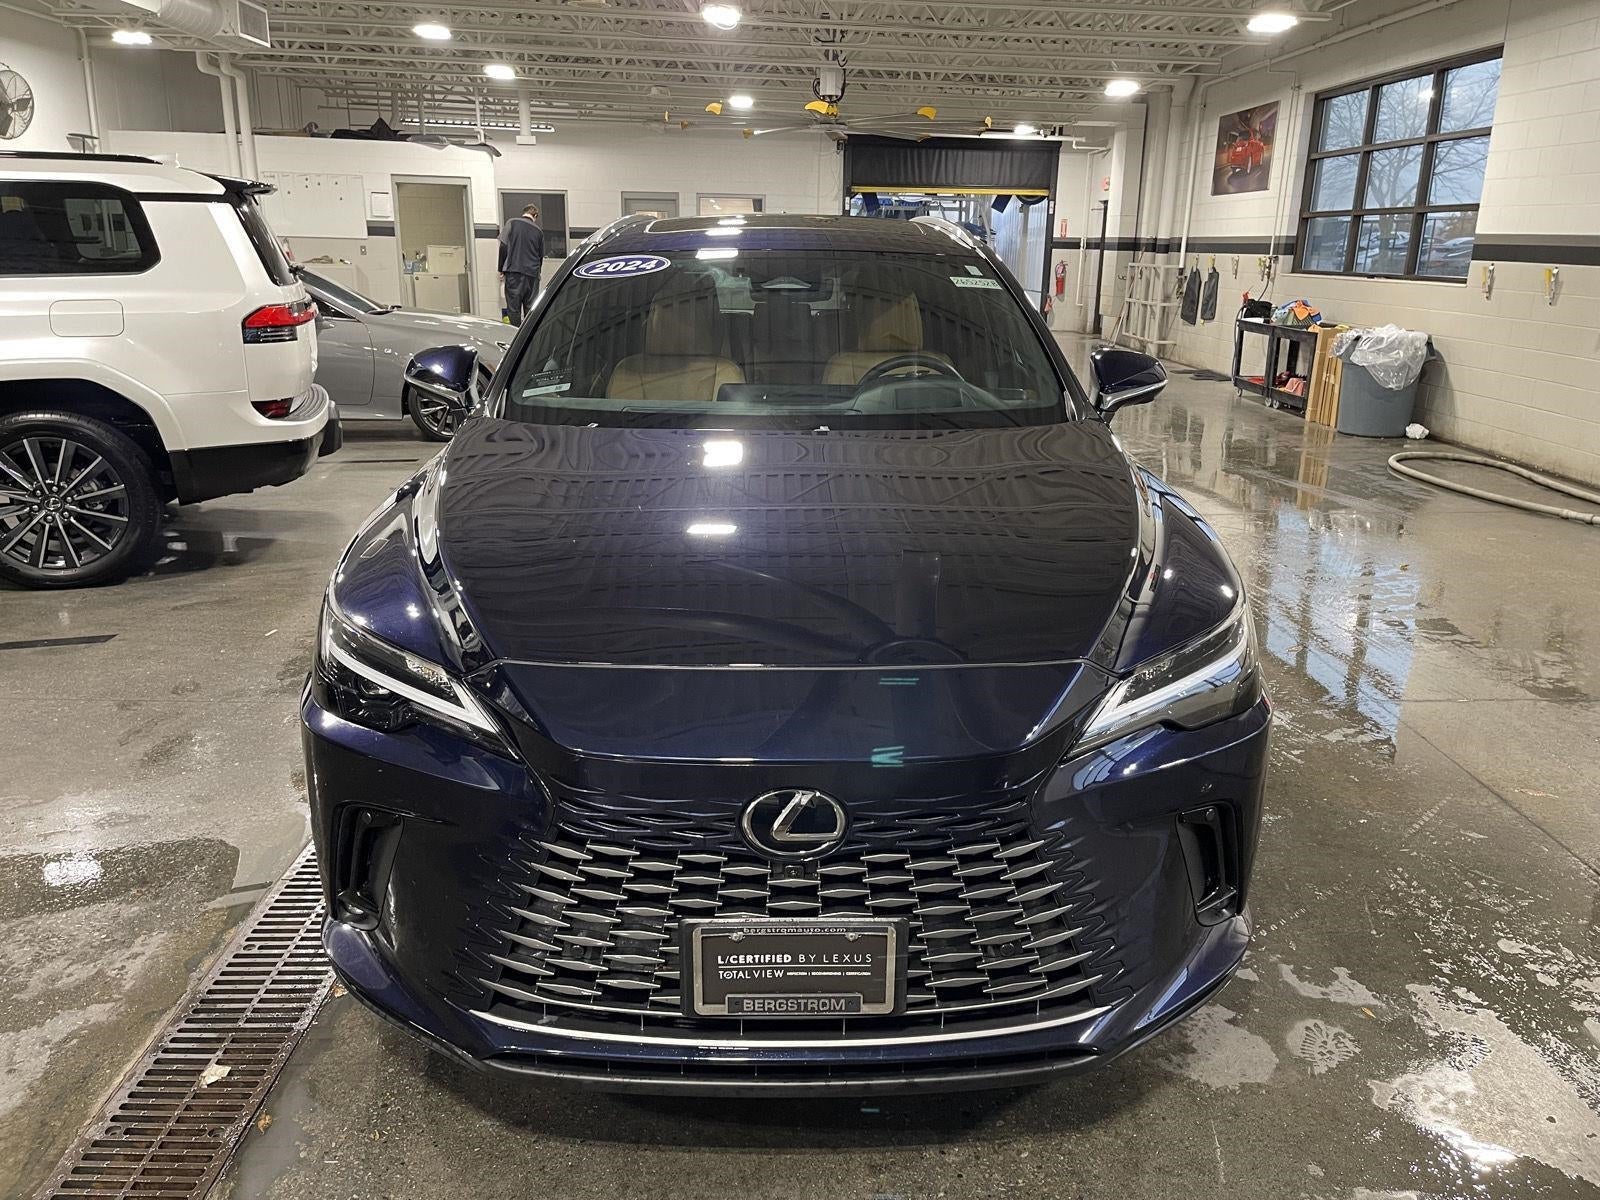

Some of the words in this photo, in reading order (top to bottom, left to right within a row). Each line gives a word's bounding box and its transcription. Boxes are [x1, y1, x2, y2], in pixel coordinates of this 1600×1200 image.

[588, 260, 659, 273] 2024
[717, 954, 792, 965] L/CERTIFIED
[798, 954, 817, 963] BY
[823, 953, 872, 963] LEXUS
[718, 970, 751, 980] TOTAL
[754, 969, 785, 979] VIEW
[743, 998, 846, 1011] BERGSTROM
